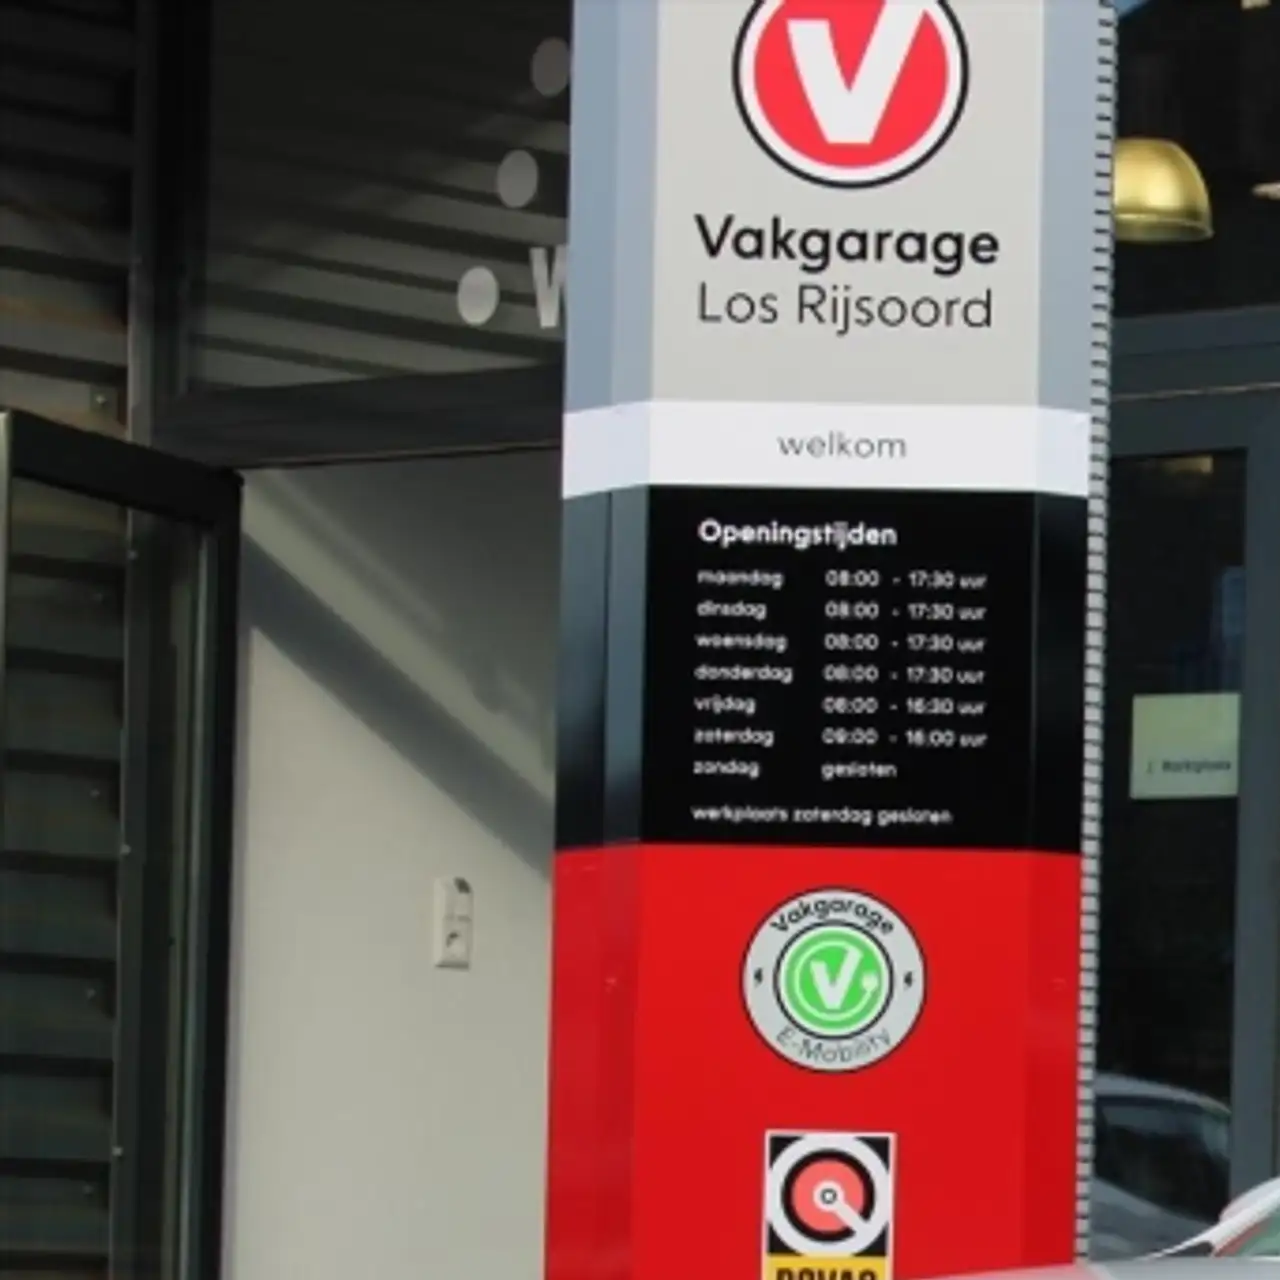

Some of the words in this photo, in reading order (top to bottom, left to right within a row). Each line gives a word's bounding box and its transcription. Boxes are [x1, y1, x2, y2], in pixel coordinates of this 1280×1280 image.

[694, 213, 1001, 275] Vakgarage
[698, 282, 779, 325] Los
[797, 284, 992, 337] Rijsoord
[777, 431, 907, 460] welkom
[698, 518, 898, 551] Openingstijden
[697, 569, 784, 590] maandag
[825, 569, 880, 587] 08:00
[908, 570, 955, 589] 17:30
[959, 576, 987, 589] uur
[696, 600, 767, 621] dinsdag
[824, 600, 880, 620] 08:00
[907, 602, 955, 621] 17:30
[958, 607, 987, 621] uur
[696, 633, 787, 653] woensdag
[824, 632, 880, 651] 08:00
[907, 633, 954, 652] 17:30
[956, 638, 985, 653] uur
[694, 664, 793, 685] donderdag
[823, 663, 879, 683] 08:00
[906, 666, 954, 684] 17:30
[956, 670, 985, 685] uur
[694, 694, 756, 715] vrijdag
[956, 702, 986, 715] uur
[694, 727, 775, 748] zaterdag
[958, 734, 988, 748] uur
[693, 759, 760, 779] zondag
[821, 761, 897, 781] gesloten
[691, 805, 789, 824] werkplaats
[793, 807, 872, 827] zaterdag
[877, 807, 951, 829] gesloten
[770, 899, 894, 934] Vakgarage
[777, 1026, 891, 1063] E-Mobility
